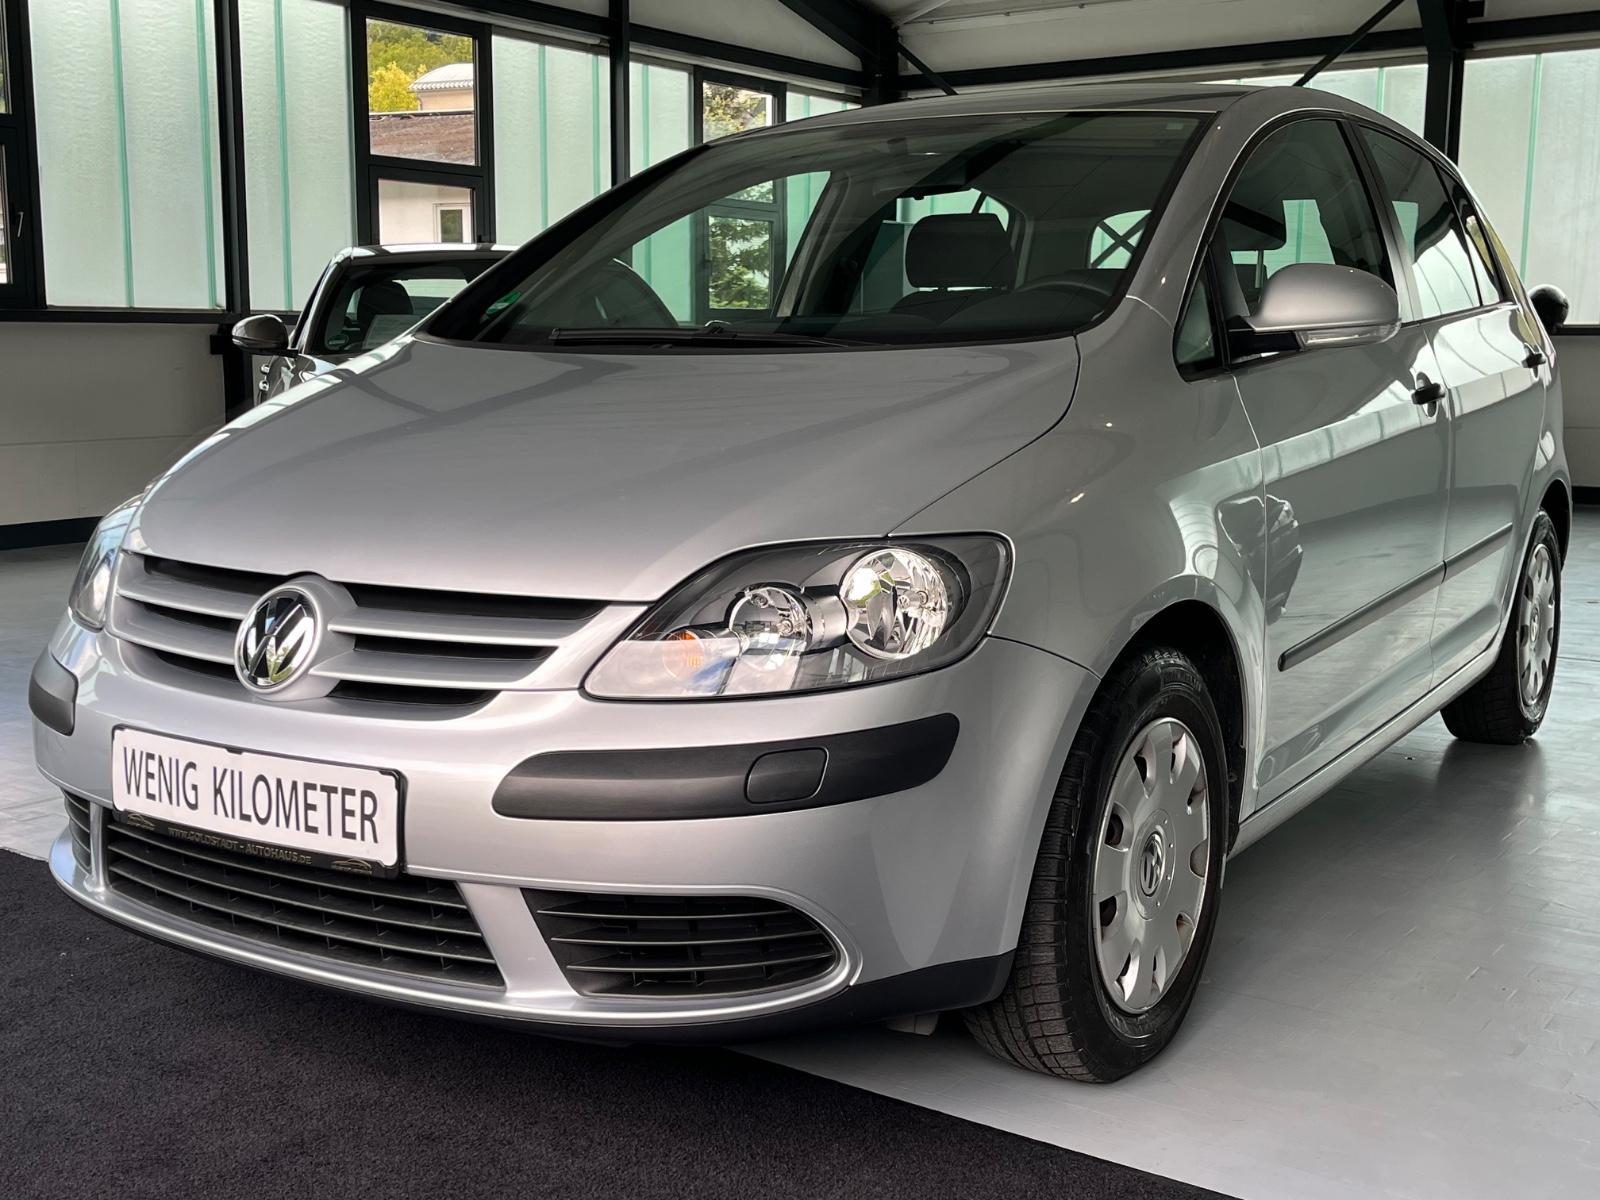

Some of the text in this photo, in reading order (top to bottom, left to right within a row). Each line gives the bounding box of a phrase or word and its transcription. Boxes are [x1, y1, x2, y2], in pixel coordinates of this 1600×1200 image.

[235, 587, 320, 692] VW
[123, 746, 378, 844] WENIG KILOMETER
